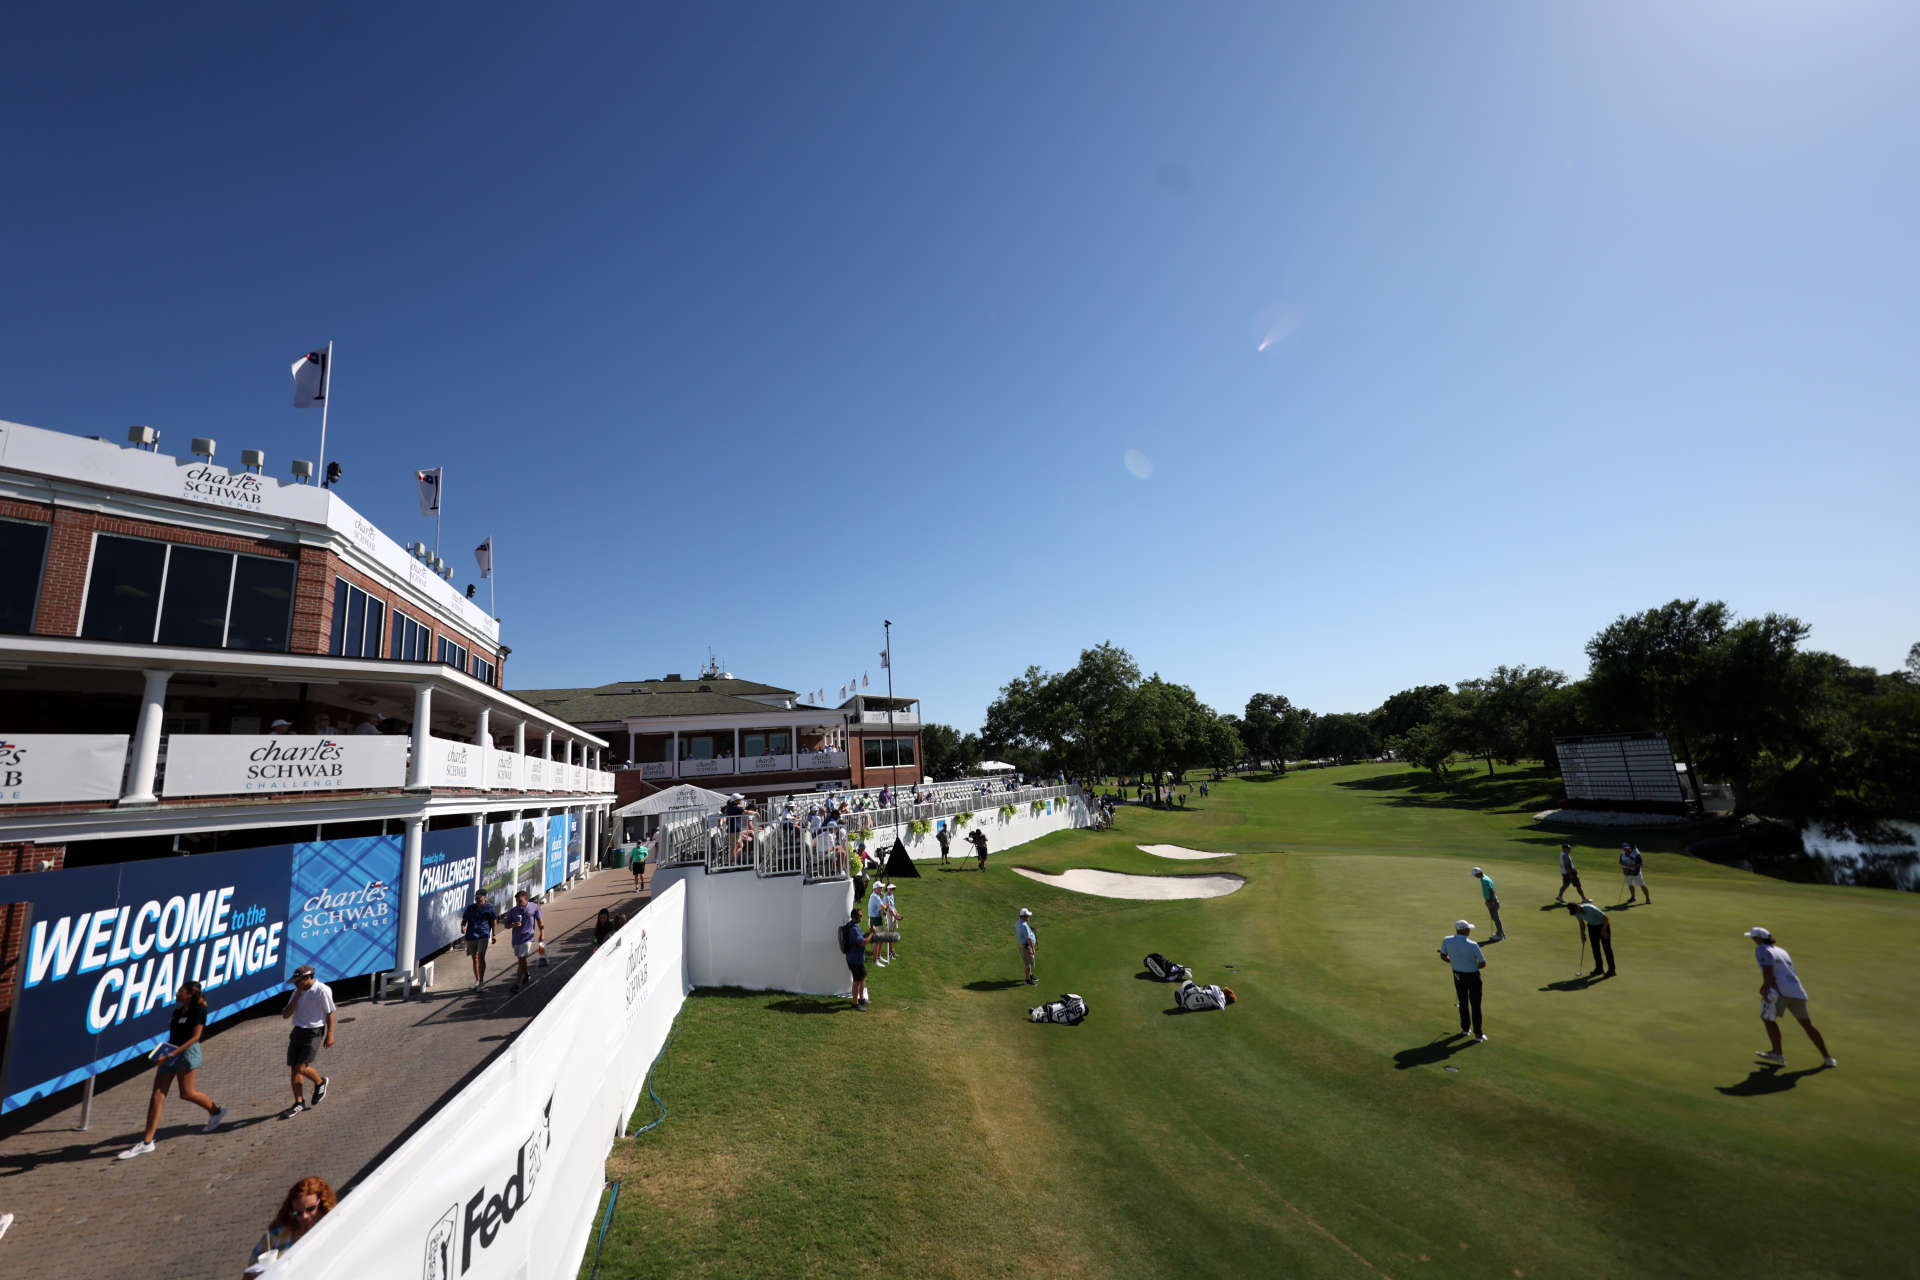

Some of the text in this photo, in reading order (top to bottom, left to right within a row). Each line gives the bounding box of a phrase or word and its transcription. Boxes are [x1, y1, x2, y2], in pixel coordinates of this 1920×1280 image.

[187, 466, 262, 492] charles
[185, 481, 262, 504] SCHWAB
[249, 739, 344, 761] charles
[245, 779, 343, 789] CHALLENGE
[247, 763, 343, 779] SCHWAB
[420, 857, 476, 897] CHALLENGER
[303, 881, 389, 912] charles
[440, 884, 470, 918] SPIRIT
[301, 918, 388, 939] CHALLENGE
[302, 902, 389, 929] SCHWAB
[24, 886, 267, 989] WELCOME to the
[86, 921, 284, 1034] CHALLENGE
[1054, 1004, 1082, 1021] PING
